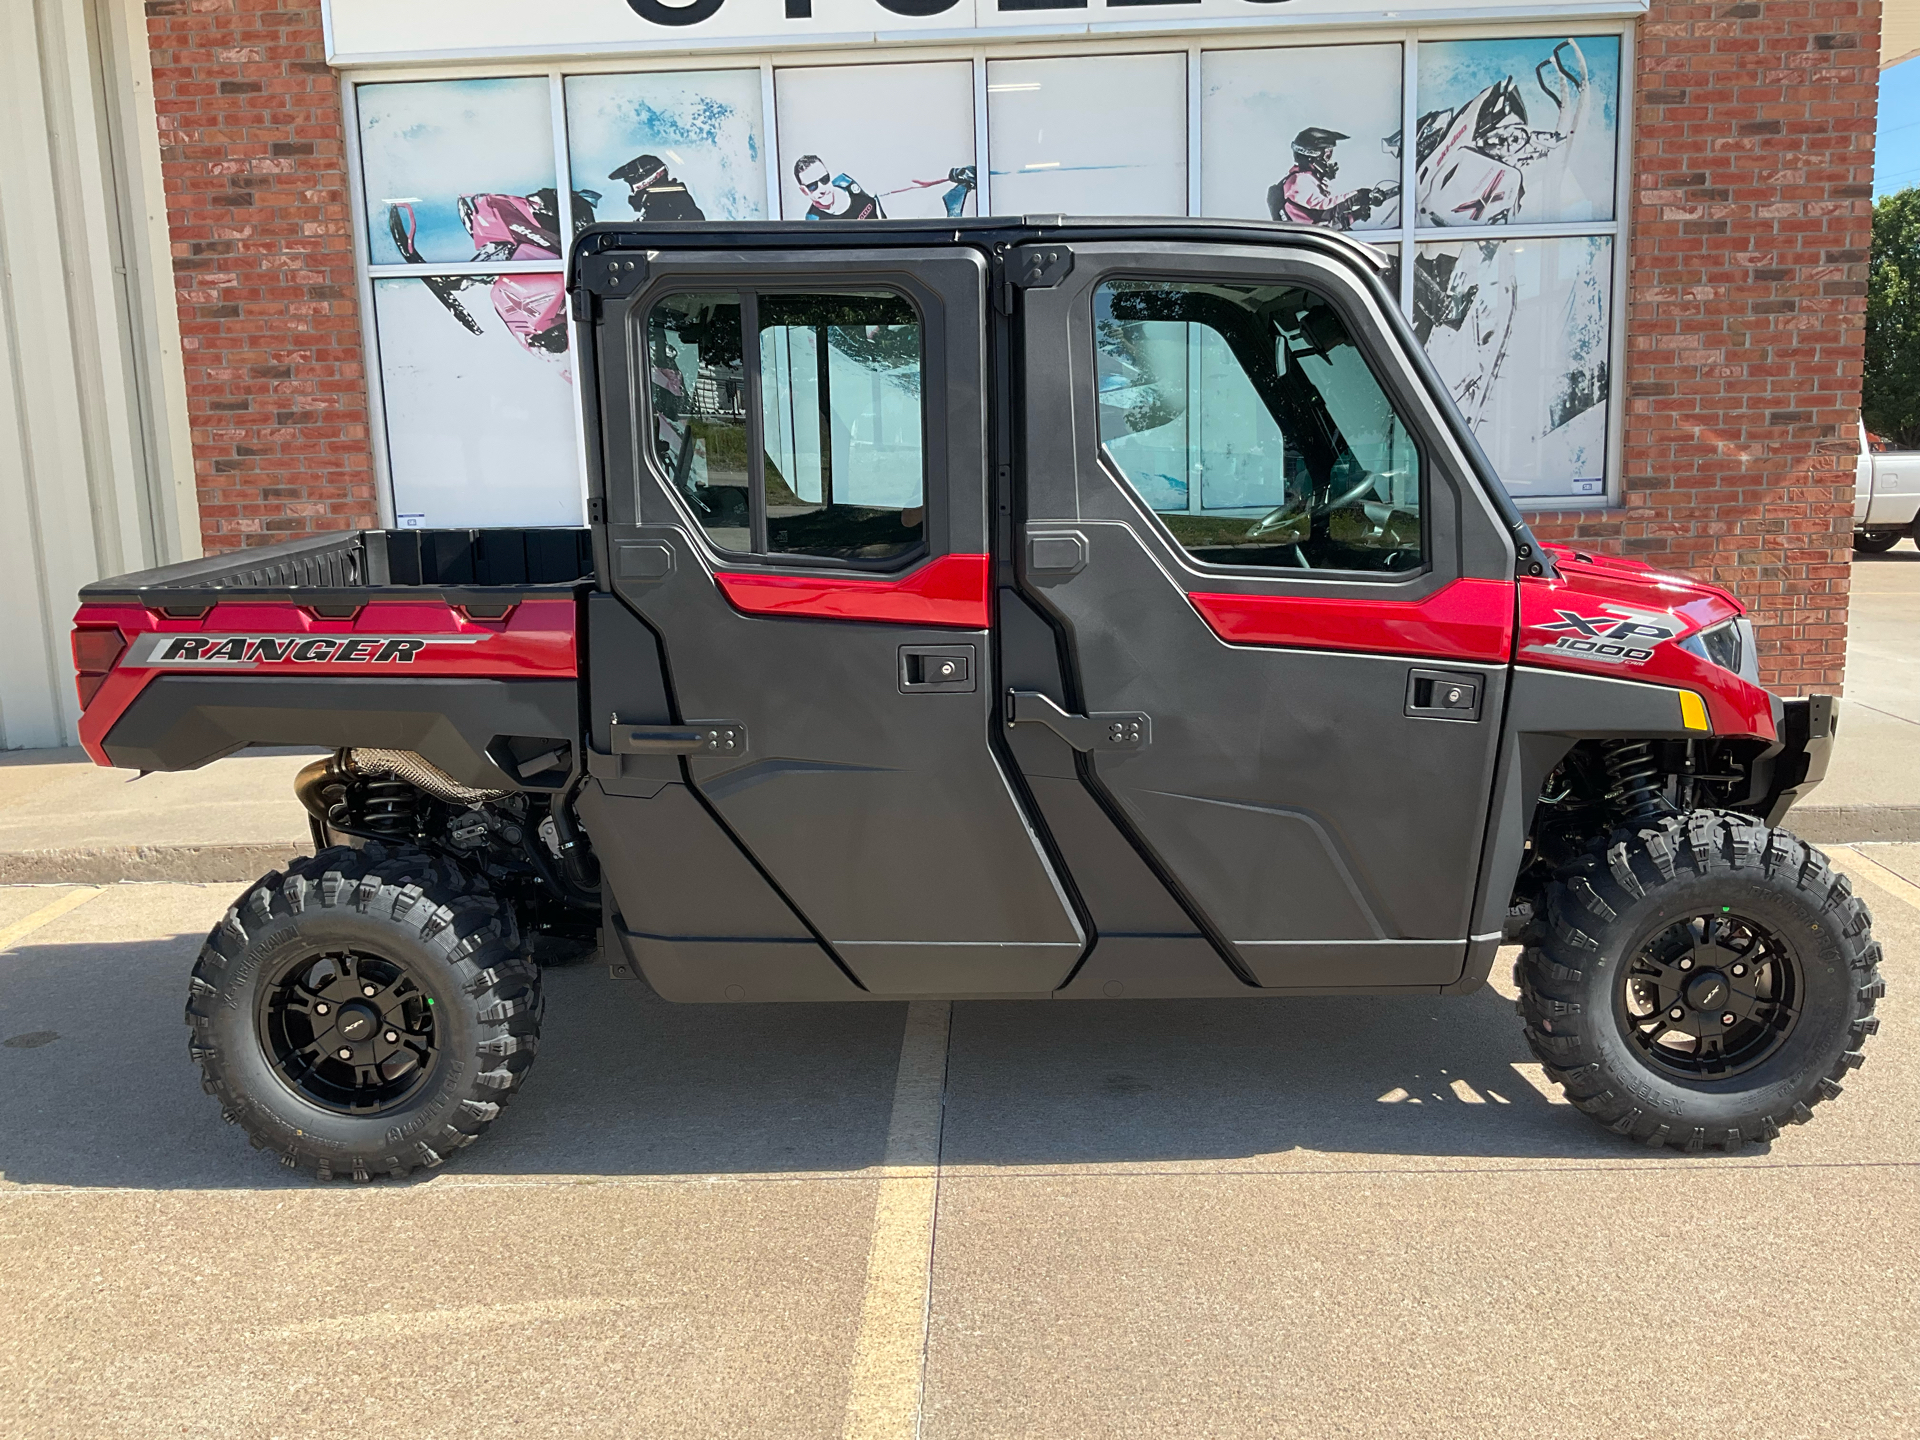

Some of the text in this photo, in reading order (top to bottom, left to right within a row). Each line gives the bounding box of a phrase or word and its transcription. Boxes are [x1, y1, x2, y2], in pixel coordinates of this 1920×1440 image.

[509, 224, 551, 247] ski-doo
[1531, 609, 1675, 641] XP
[159, 637, 426, 663] RANGER
[1555, 636, 1655, 661] 1000
[1624, 659, 1645, 667] CAM
